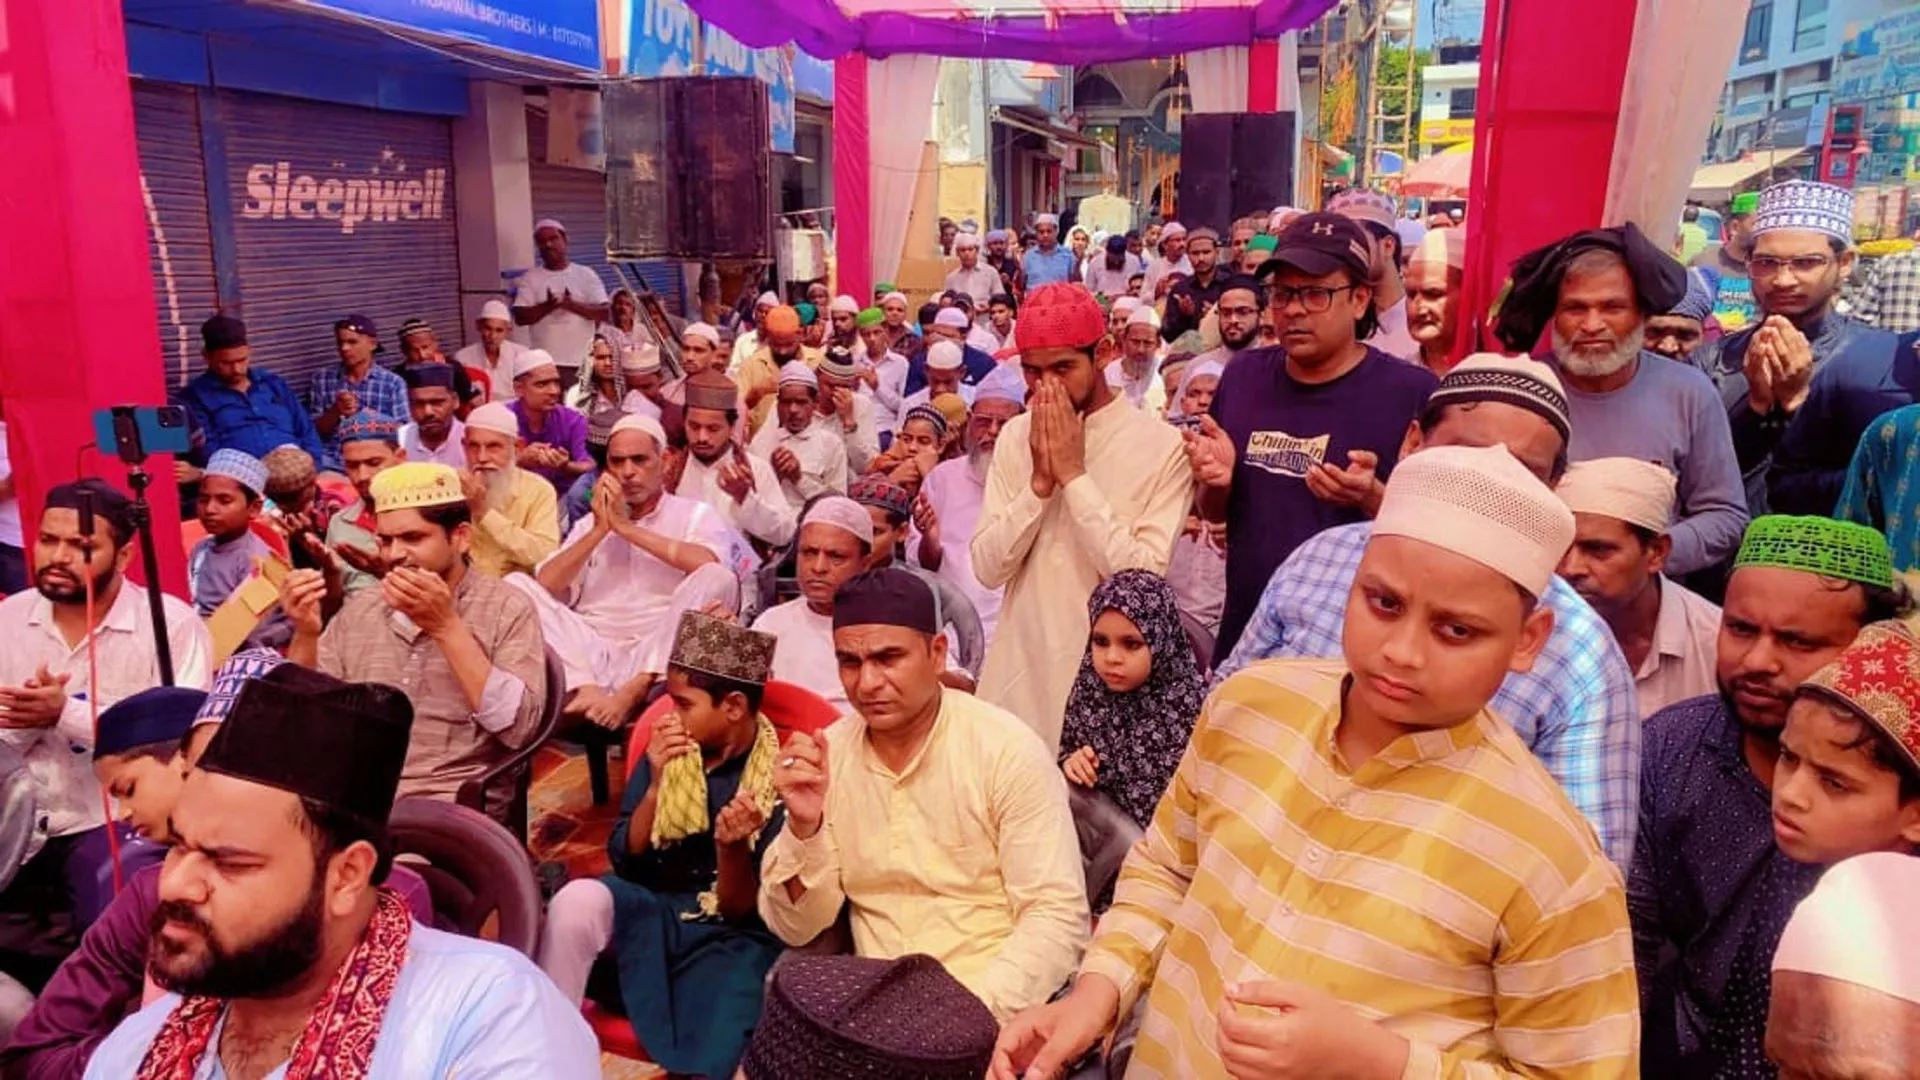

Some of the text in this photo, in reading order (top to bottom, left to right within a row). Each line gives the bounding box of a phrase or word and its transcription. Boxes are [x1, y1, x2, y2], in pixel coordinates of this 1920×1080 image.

[478, 3, 532, 34] BROTHERS
[242, 161, 446, 234] Sleepwell
[1309, 442, 1323, 460] in
